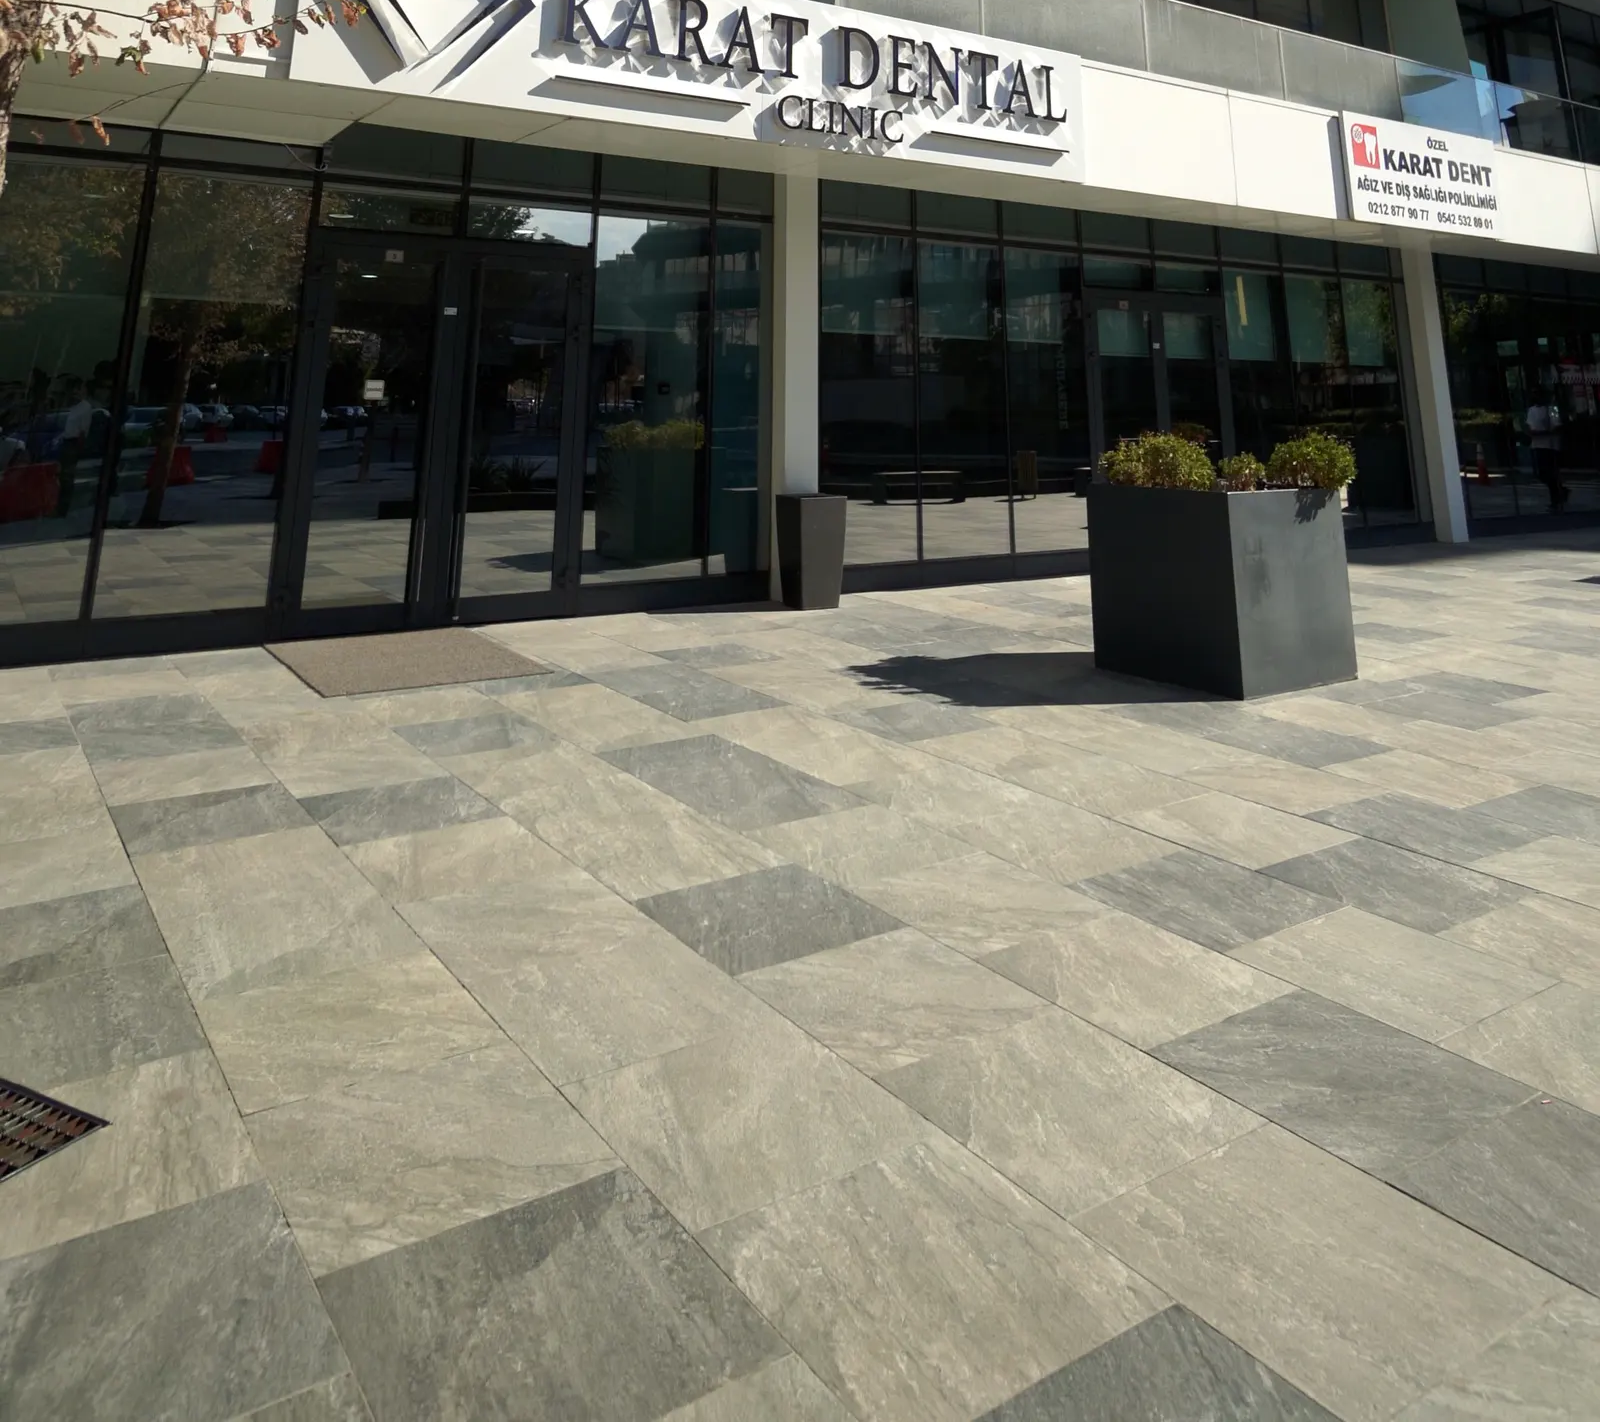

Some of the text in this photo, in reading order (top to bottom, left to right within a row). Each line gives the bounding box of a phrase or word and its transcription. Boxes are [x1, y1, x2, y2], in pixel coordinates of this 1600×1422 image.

[837, 26, 1068, 123] DENTAL
[776, 94, 905, 144] CLINIC
[1426, 135, 1449, 152] ÖZEL
[1382, 148, 1492, 188] KARAT DENT
[1357, 174, 1498, 211] AĞIZ VE DİŞ SAĞLIĞI POLİKLİNİĞİ
[1368, 201, 1390, 216] 0212
[1390, 204, 1405, 218] 877
[1407, 207, 1419, 220] 90
[1419, 208, 1430, 222] 77
[1437, 211, 1457, 225] 0542
[1457, 214, 1473, 227] 532
[1483, 218, 1494, 231] 01
